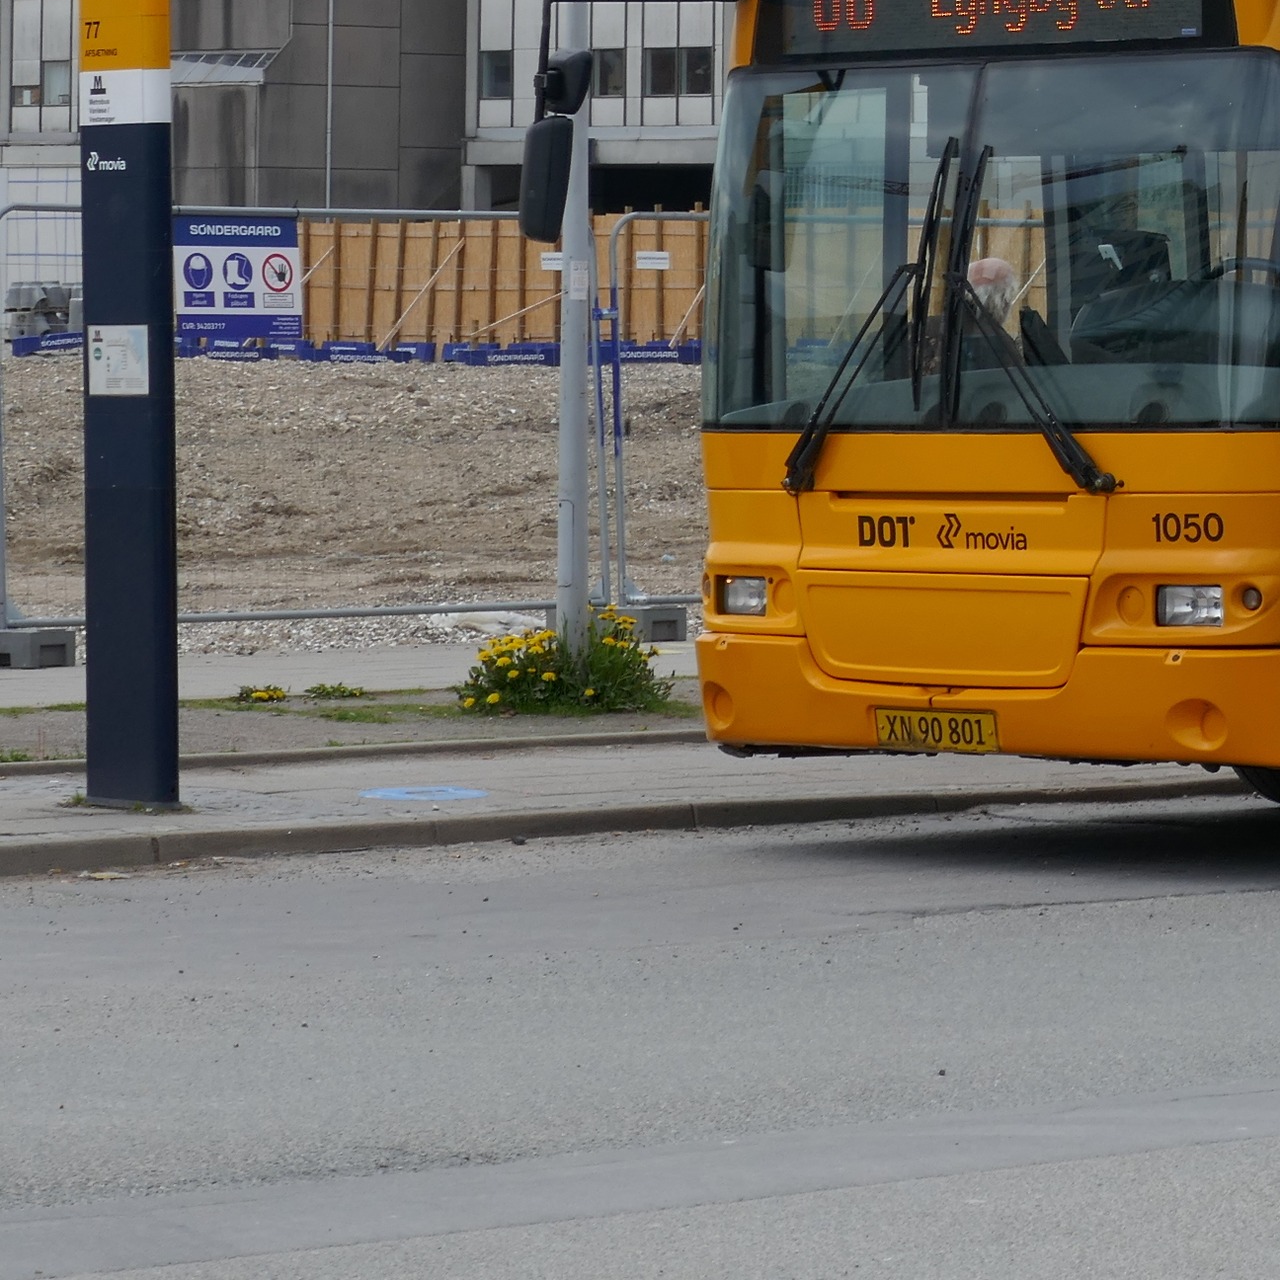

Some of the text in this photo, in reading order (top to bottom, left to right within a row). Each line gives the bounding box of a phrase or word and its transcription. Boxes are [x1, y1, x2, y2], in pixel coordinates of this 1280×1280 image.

[84, 21, 100, 39] 77
[98, 156, 126, 170] movia
[858, 515, 1027, 551] DOT movia
[1152, 512, 1224, 543] 1050
[885, 715, 986, 746] XN 90 801
